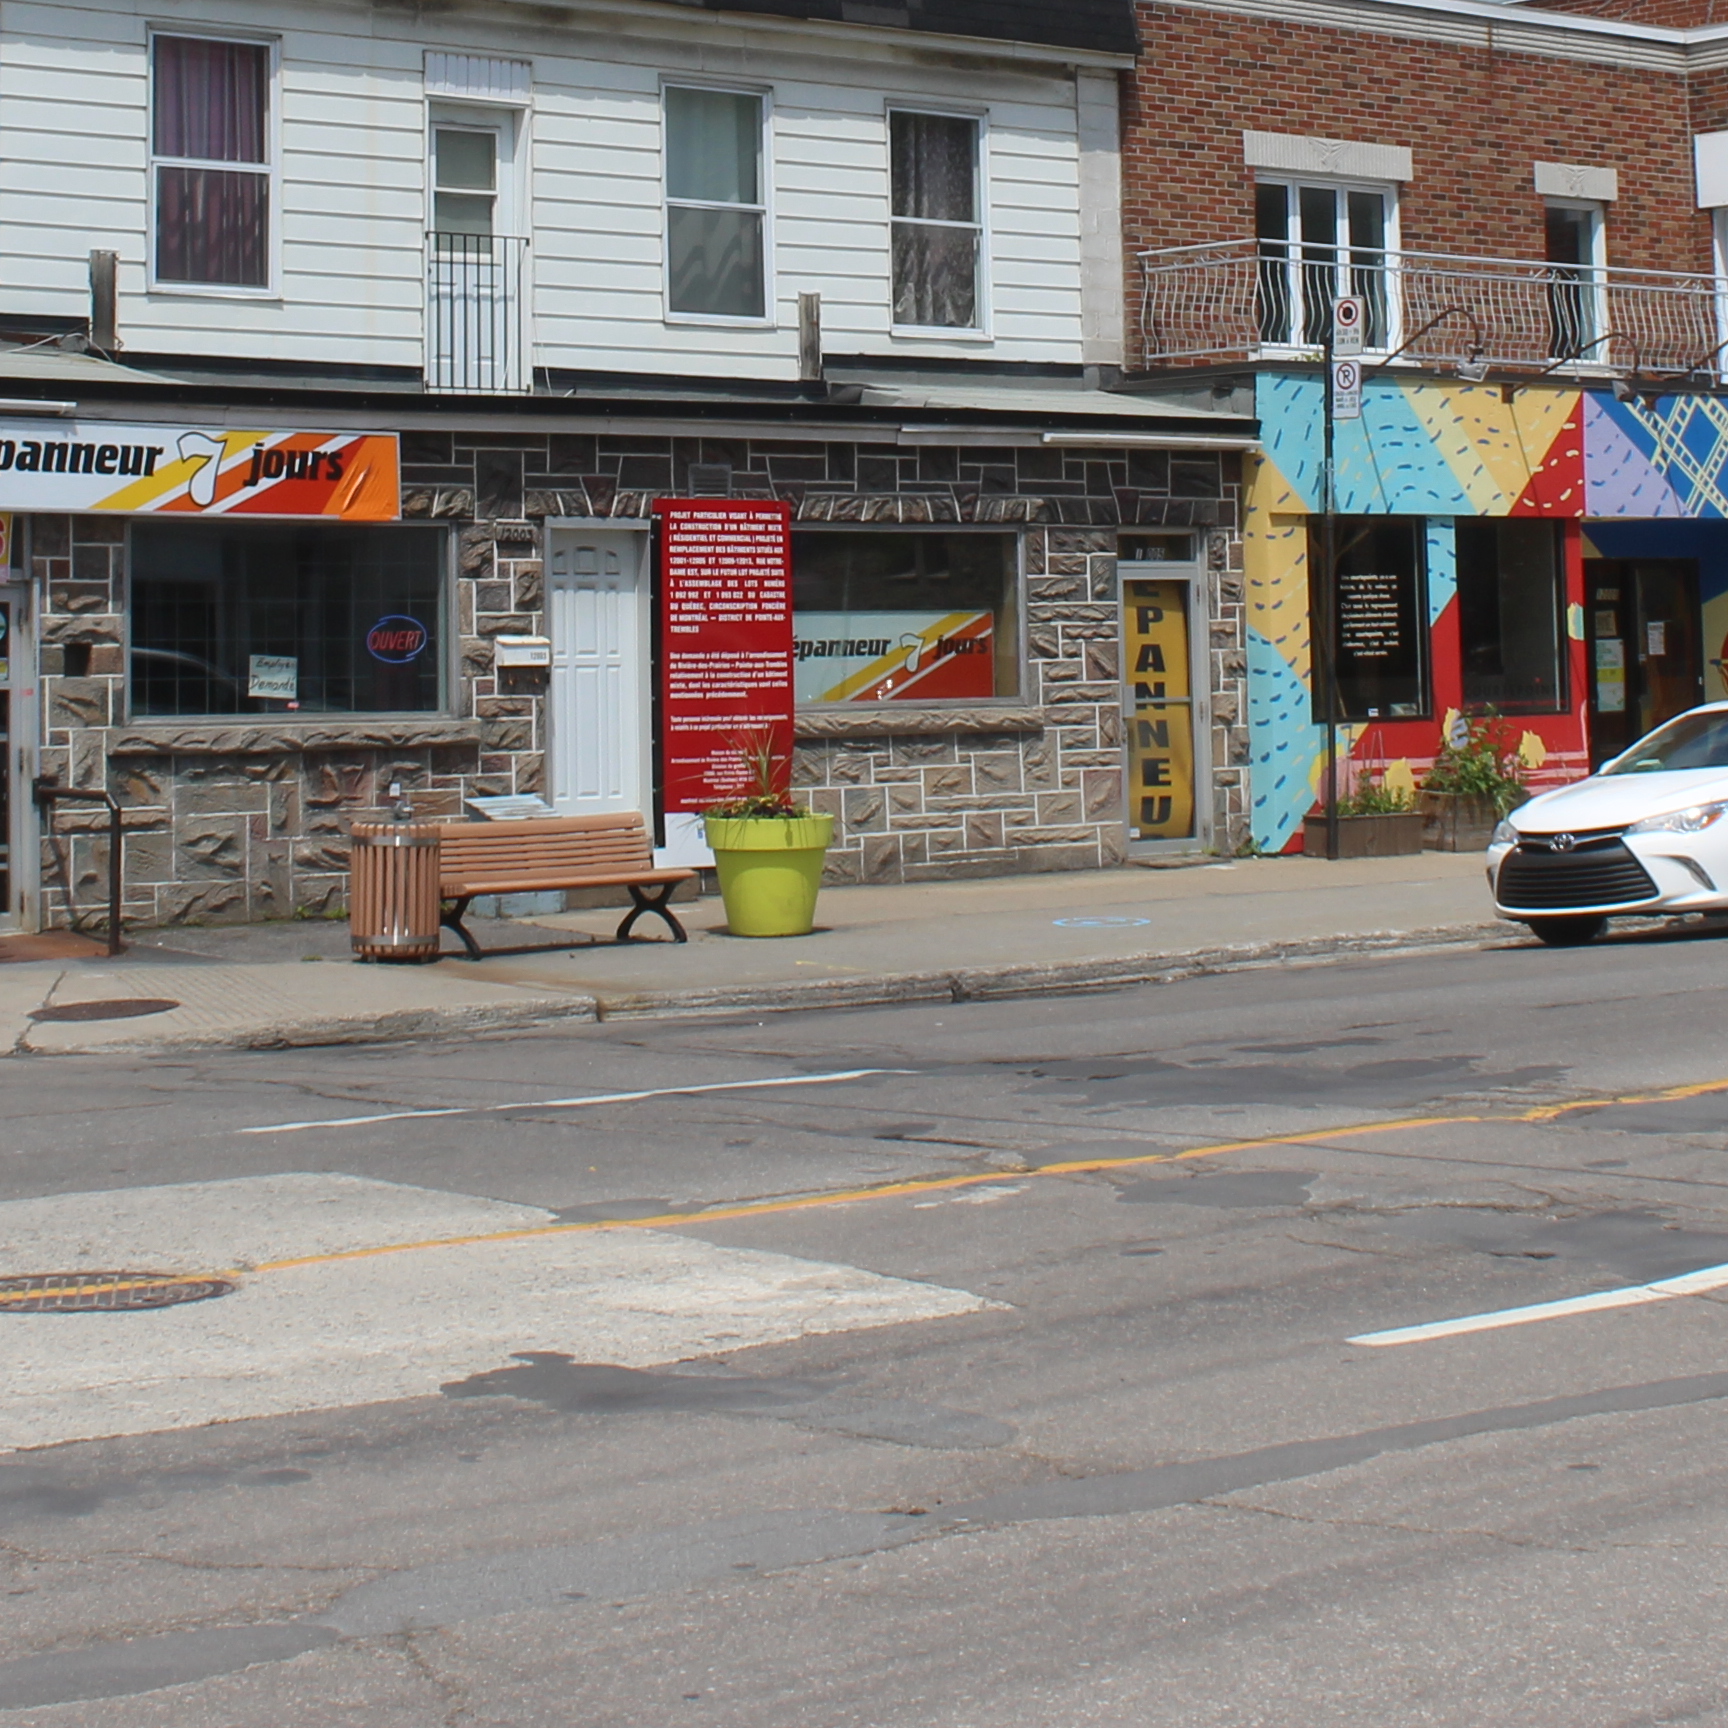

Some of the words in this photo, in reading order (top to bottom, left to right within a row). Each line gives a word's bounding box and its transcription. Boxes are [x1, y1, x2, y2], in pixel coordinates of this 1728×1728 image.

[176, 431, 228, 508] 7
[243, 441, 344, 487] jours
[371, 631, 422, 650] OUVERT
[792, 635, 891, 661] épanneur
[899, 633, 925, 673] 7
[933, 635, 987, 660] jours
